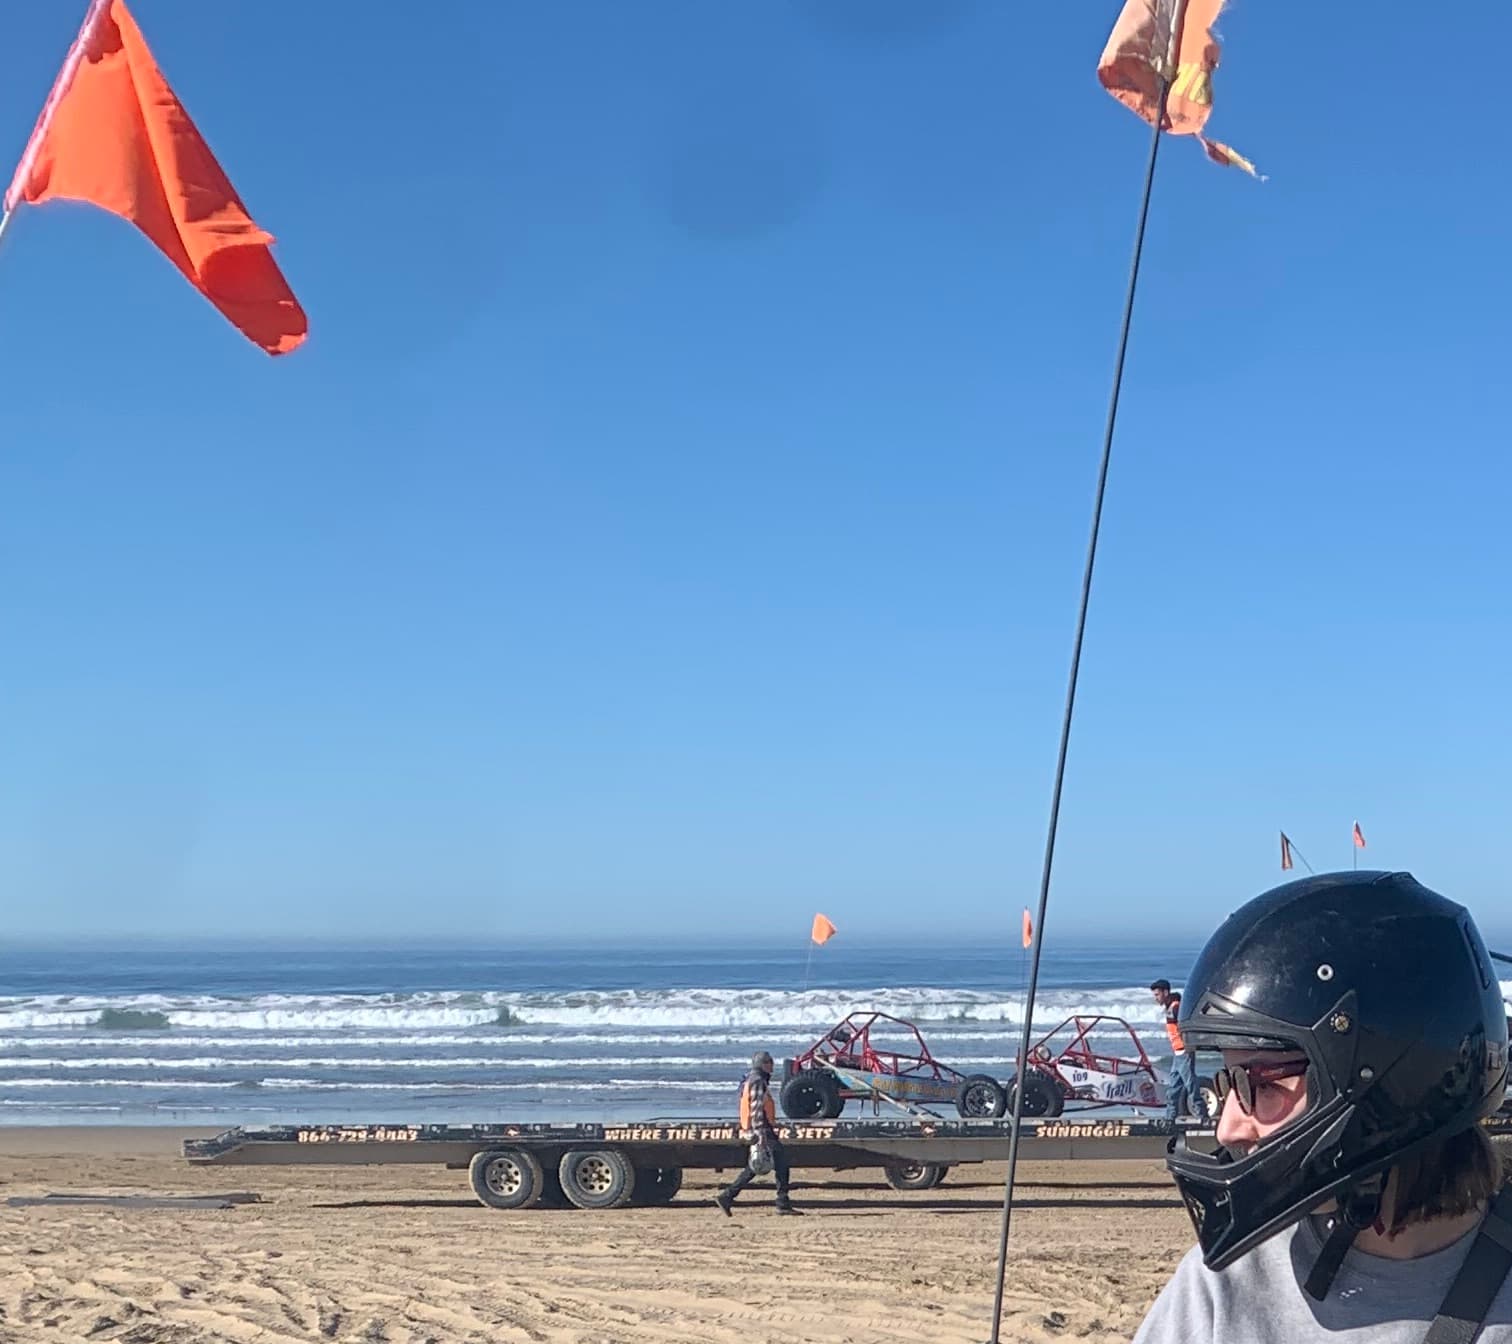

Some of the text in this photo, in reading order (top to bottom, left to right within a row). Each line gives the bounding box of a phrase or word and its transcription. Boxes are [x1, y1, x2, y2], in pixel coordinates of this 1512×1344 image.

[604, 1128, 662, 1140] WHERE
[666, 1128, 697, 1140] THE
[700, 1128, 733, 1140] FUN
[796, 1127, 833, 1139] SETS
[1036, 1125, 1131, 1137] SUNBUGGIE
